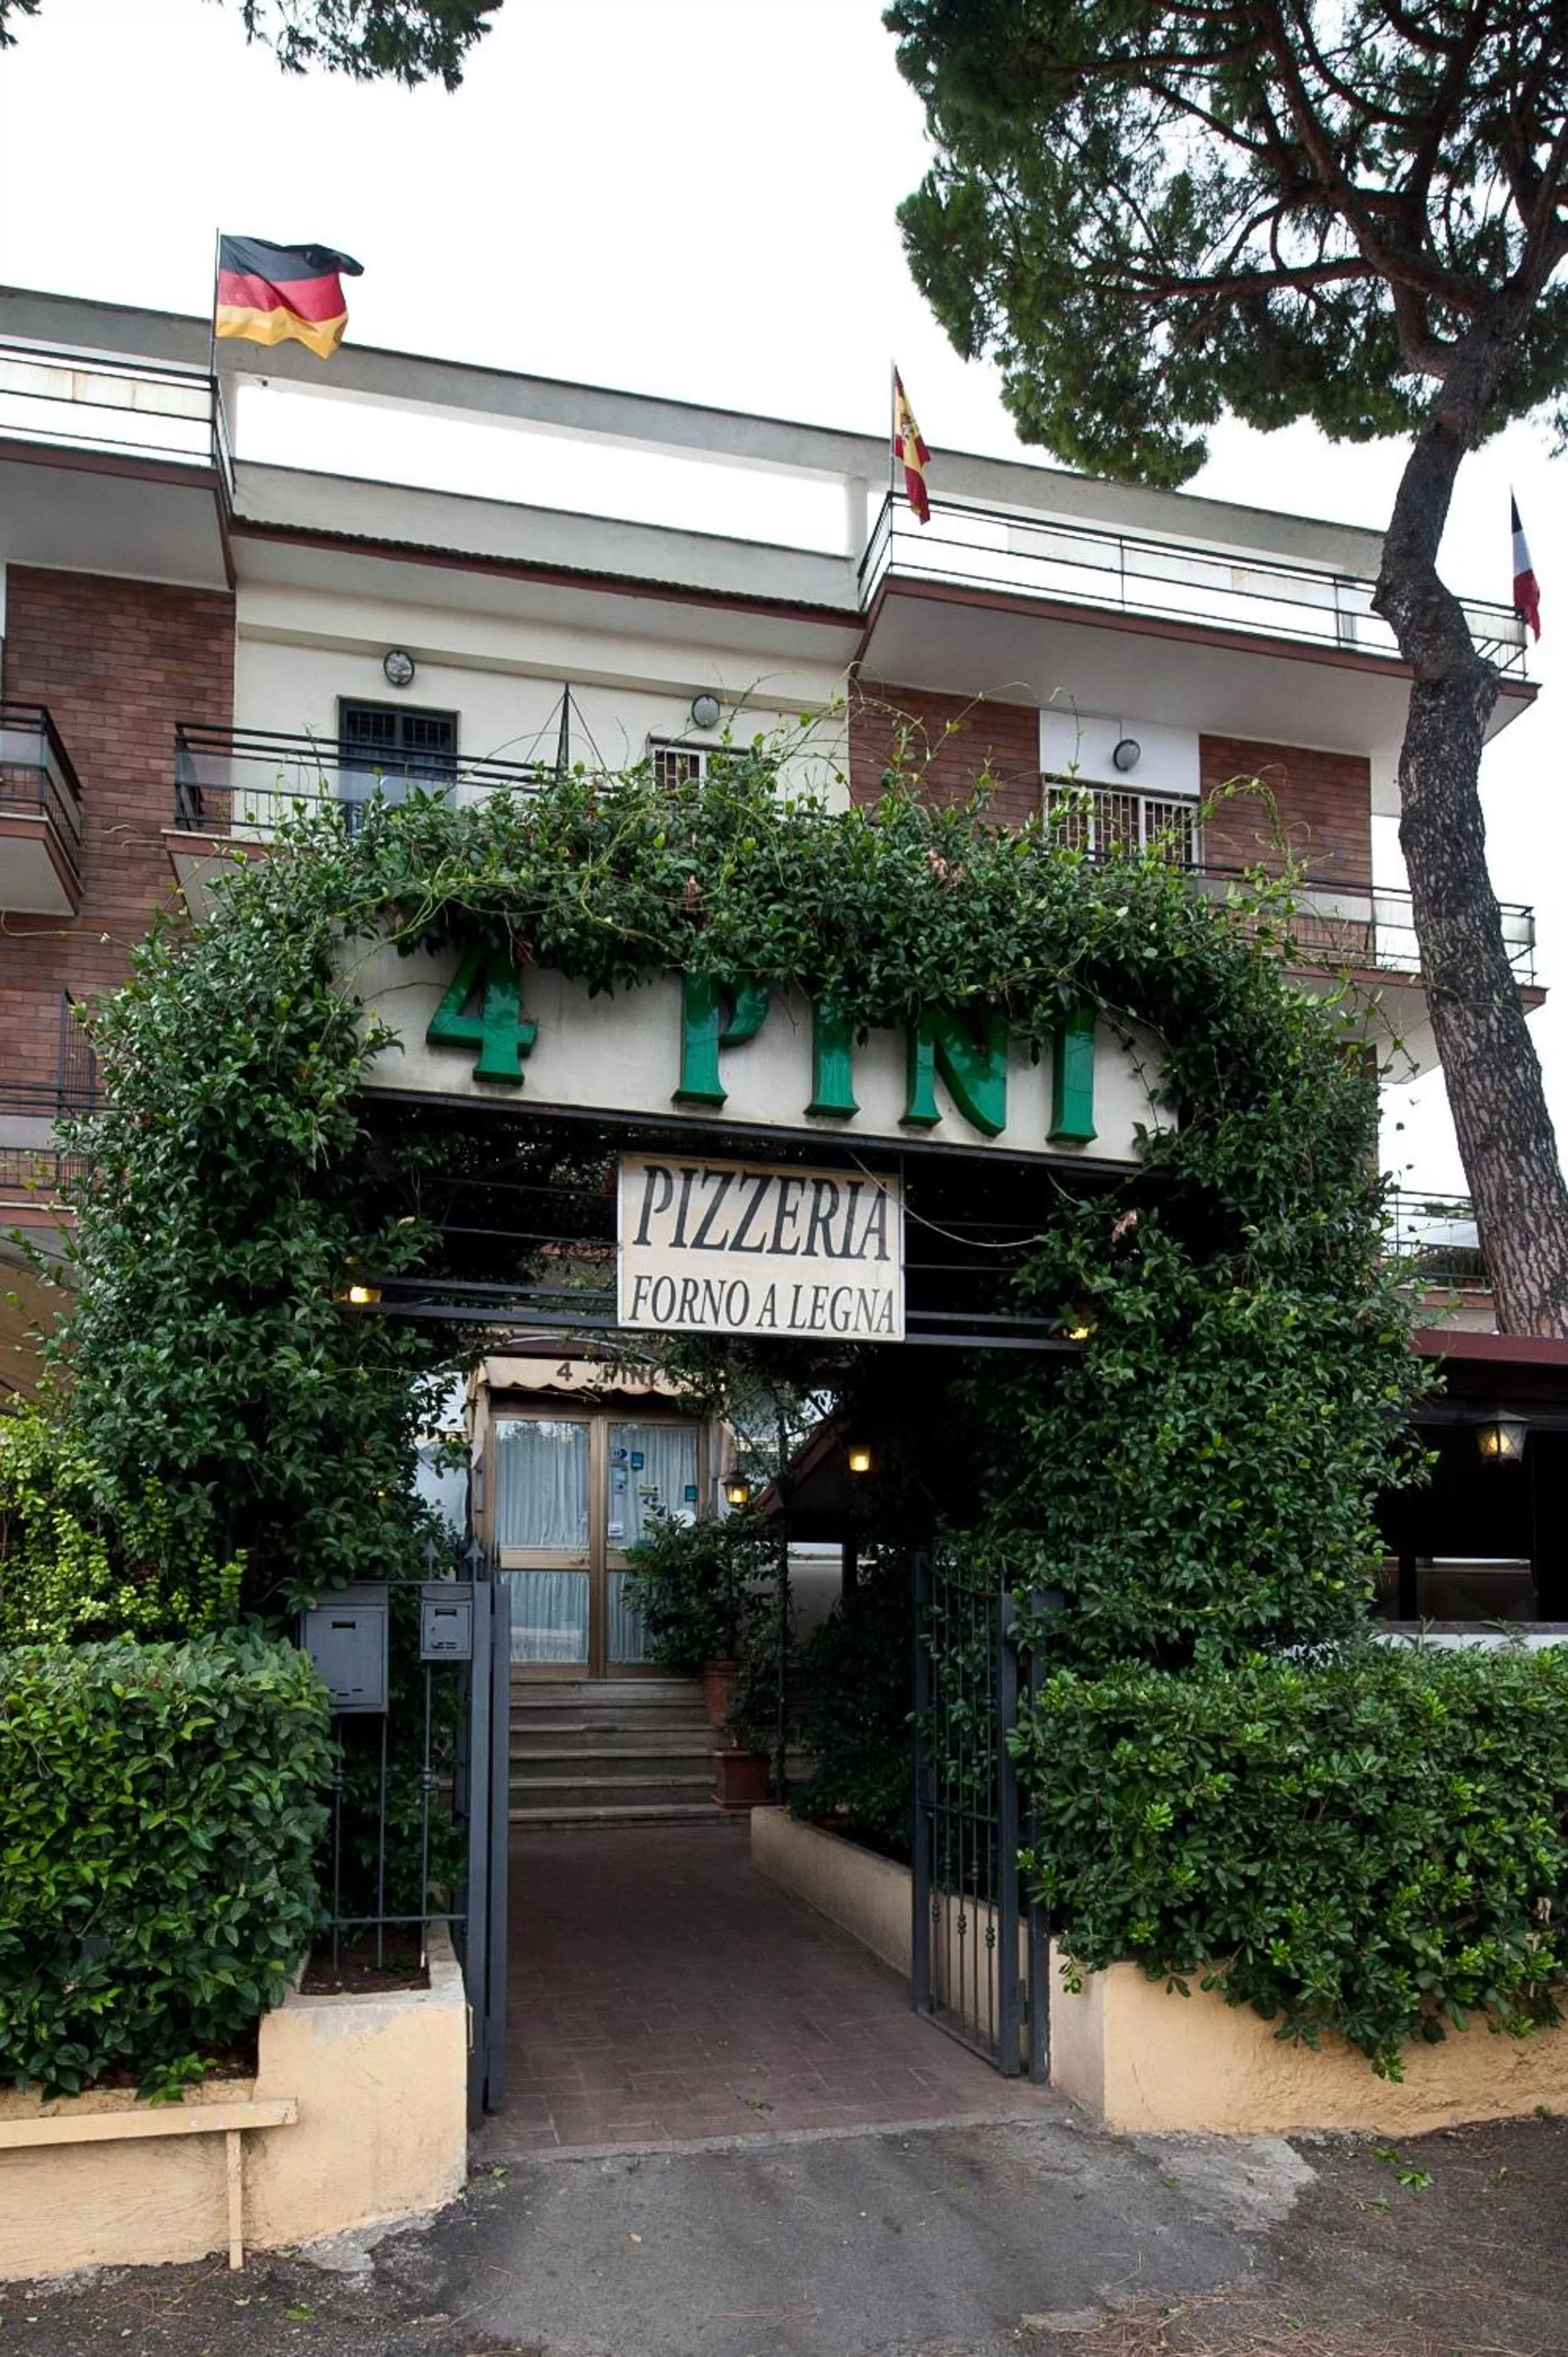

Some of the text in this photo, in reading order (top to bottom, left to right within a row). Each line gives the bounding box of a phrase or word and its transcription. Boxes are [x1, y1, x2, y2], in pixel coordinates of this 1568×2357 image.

[425, 947, 1098, 1144] 4 PINI
[633, 1165, 891, 1261] PIZZERIA
[629, 1275, 895, 1334] FORNO A LEGNA
[556, 1361, 573, 1381] 4
